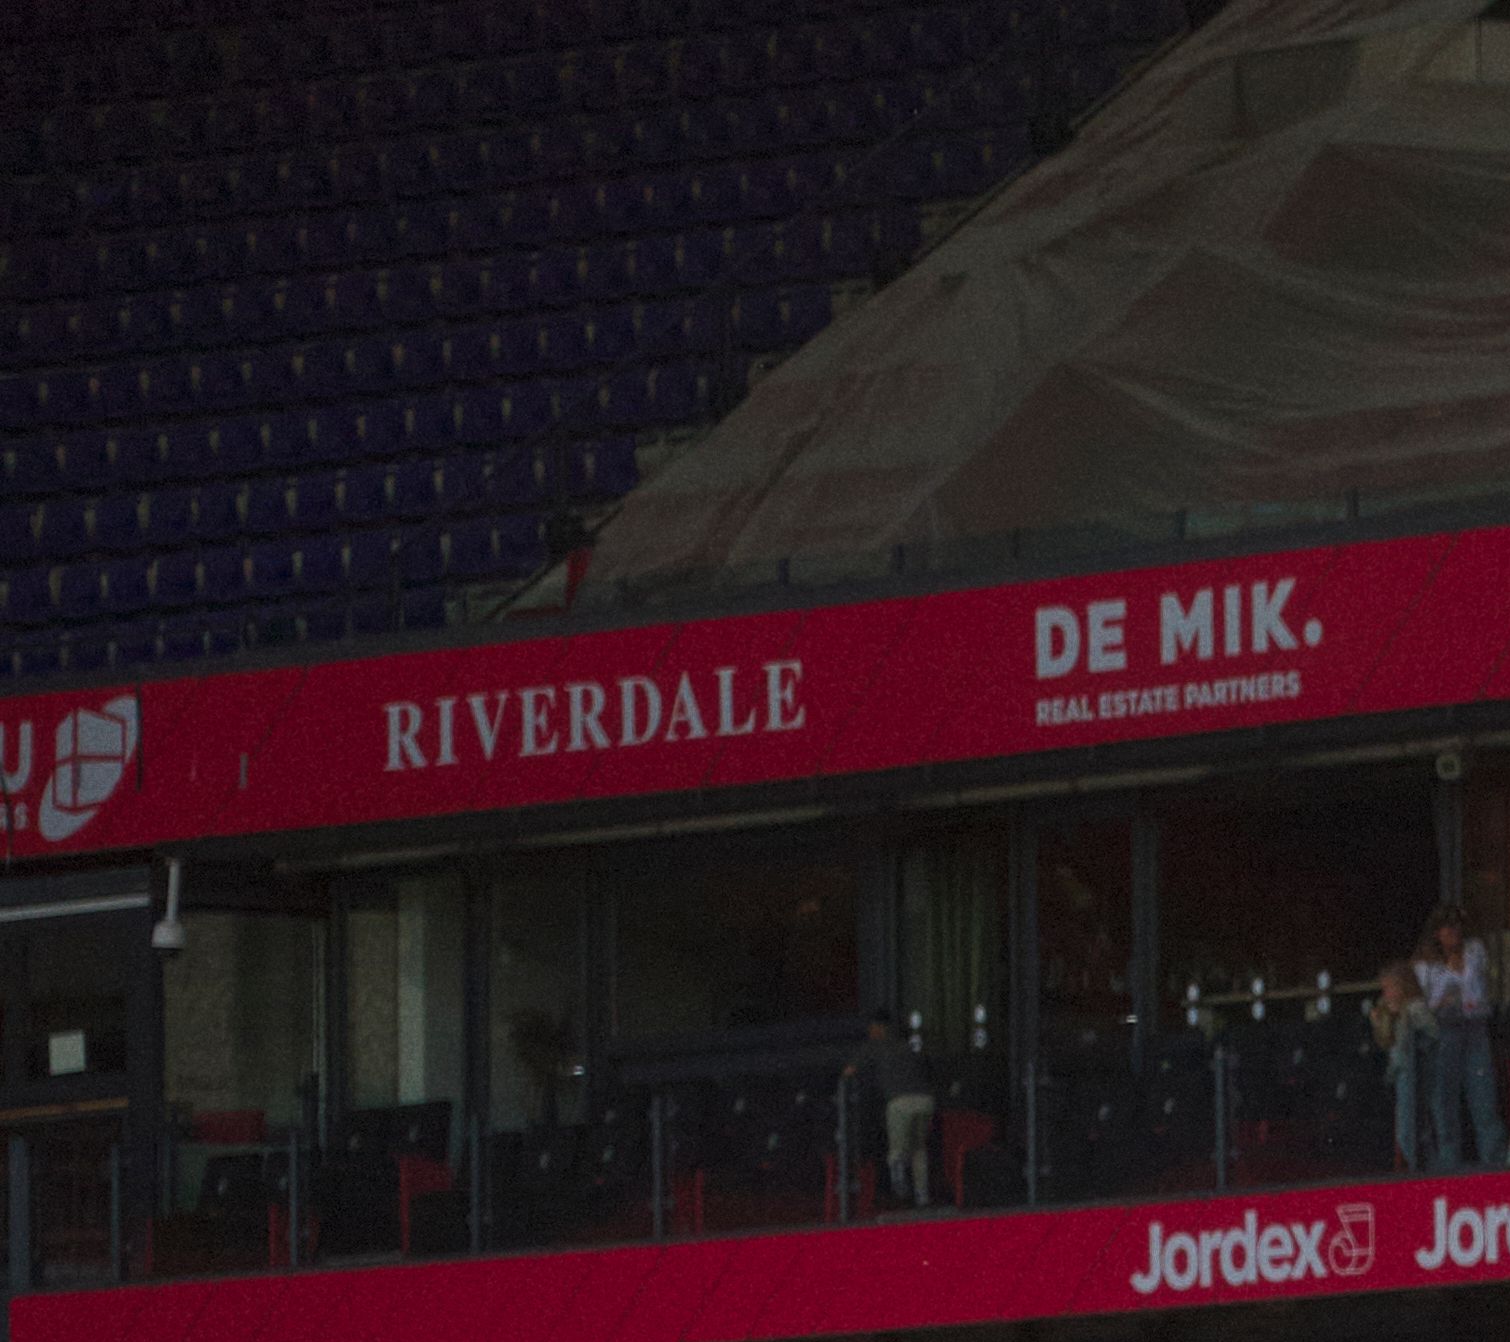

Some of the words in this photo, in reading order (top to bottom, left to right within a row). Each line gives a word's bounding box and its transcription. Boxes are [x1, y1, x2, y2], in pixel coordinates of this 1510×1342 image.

[1034, 602, 1127, 680] DE
[1159, 577, 1324, 665] MIK.
[384, 659, 806, 771] RIVERDALE
[1035, 697, 1095, 726] REAL
[1097, 687, 1180, 720] ESTATE
[1182, 672, 1302, 709] PARTNERS
[1130, 1210, 1328, 1294] Jordex
